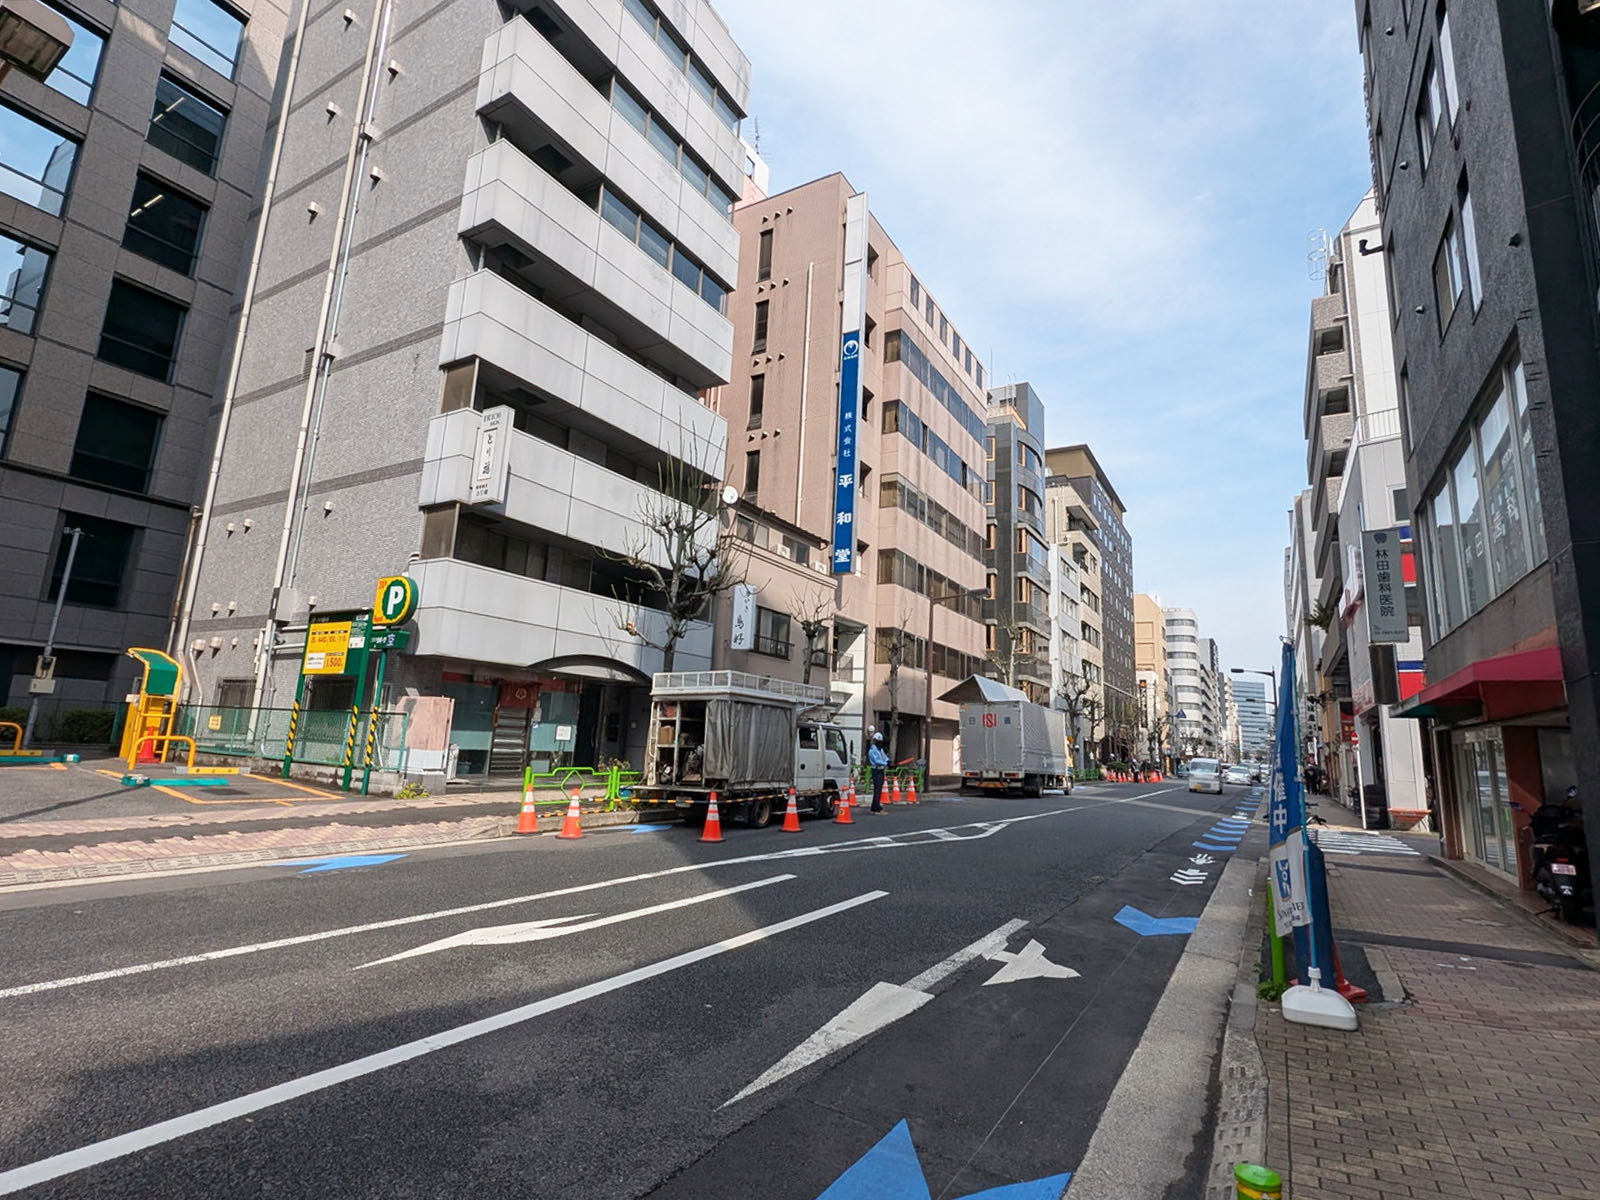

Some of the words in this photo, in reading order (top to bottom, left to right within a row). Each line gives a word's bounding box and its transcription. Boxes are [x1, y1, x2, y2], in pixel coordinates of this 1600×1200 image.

[386, 586, 405, 615] P
[1375, 549, 1396, 617] 林田歯科医院
